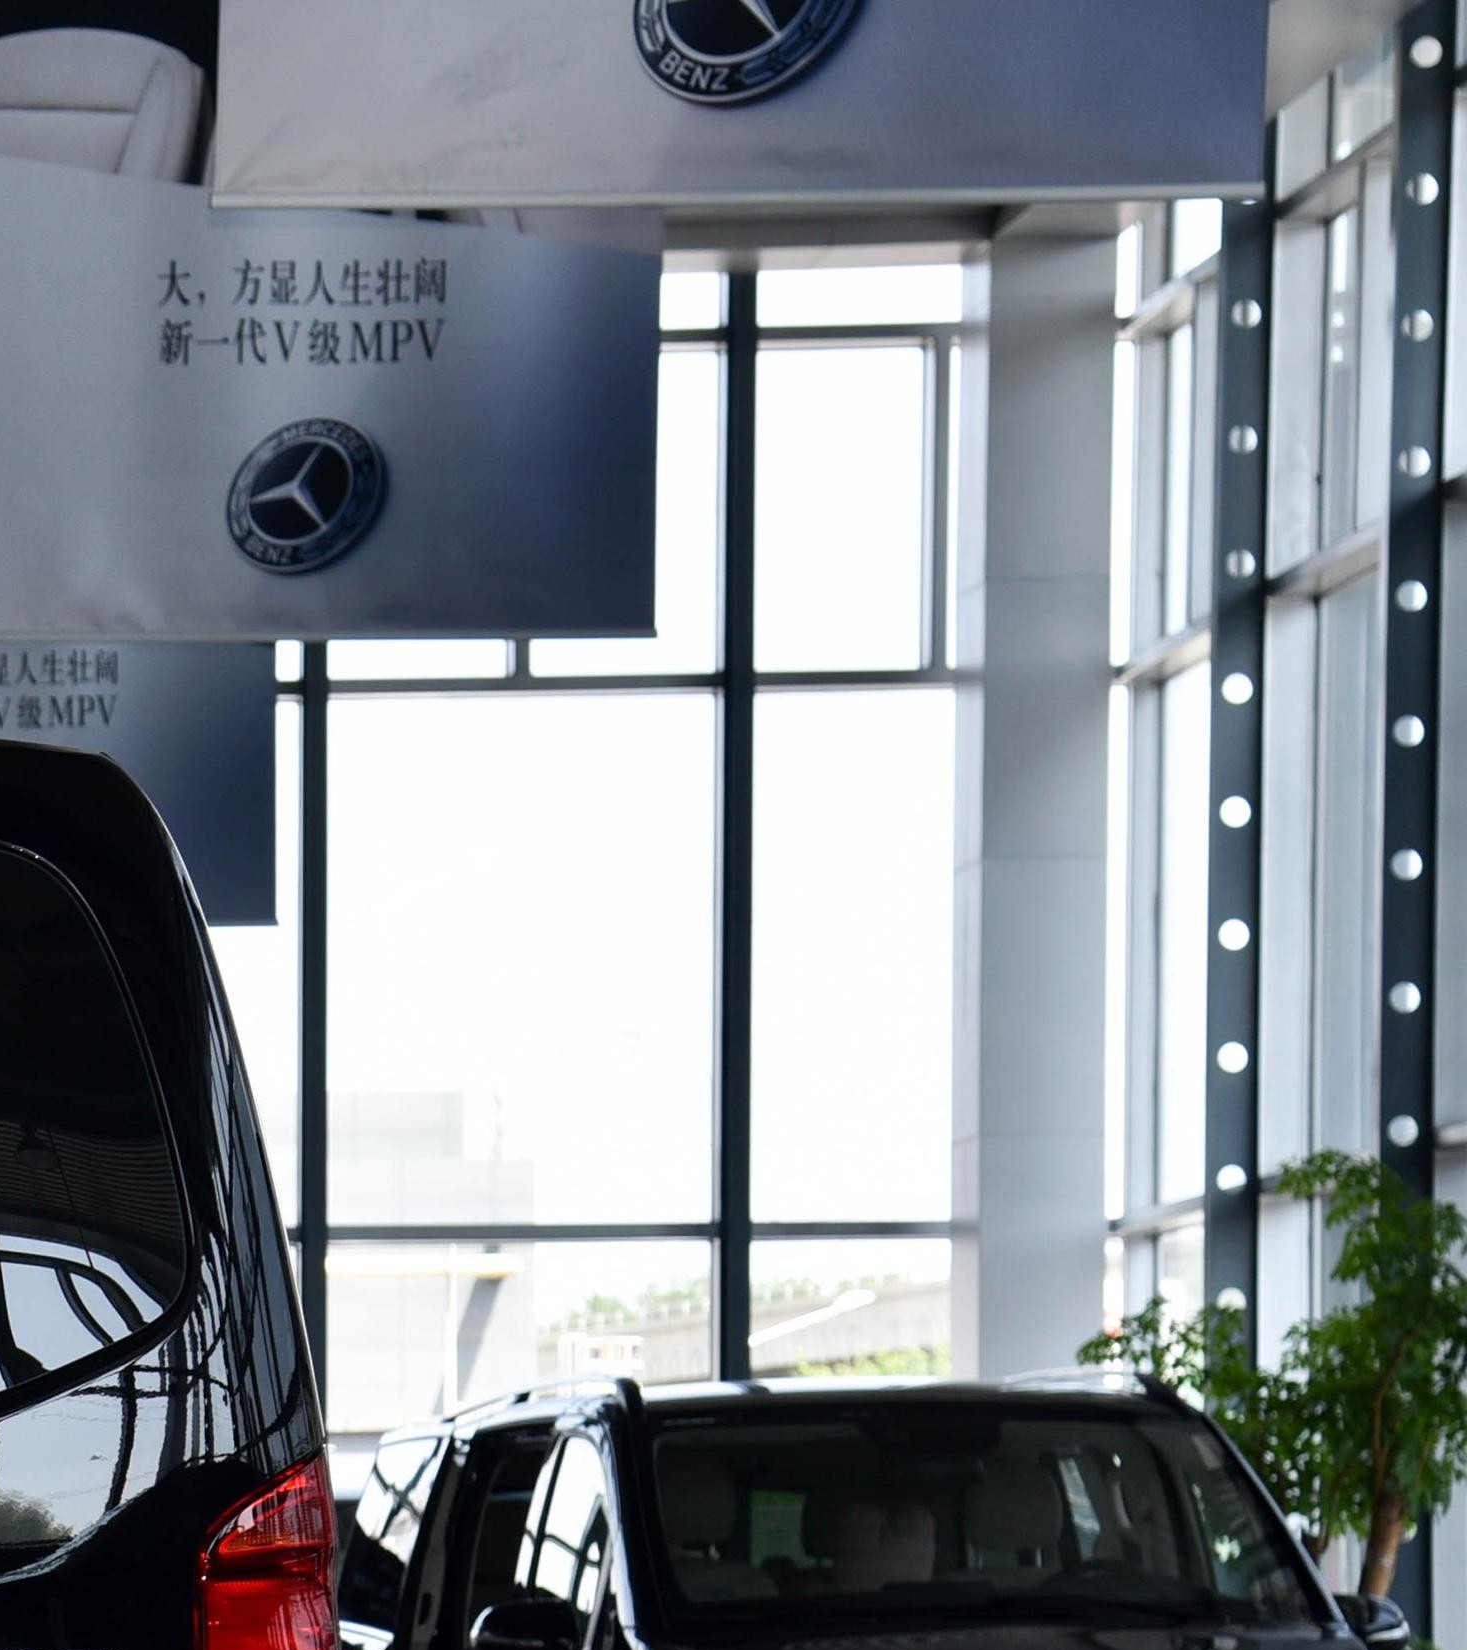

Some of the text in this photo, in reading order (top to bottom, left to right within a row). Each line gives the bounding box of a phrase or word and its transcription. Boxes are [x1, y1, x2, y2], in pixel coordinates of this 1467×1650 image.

[658, 50, 731, 91] BENZ
[157, 257, 447, 307] 大，方显人生壮阔
[158, 316, 446, 367] 新一代V级MPV
